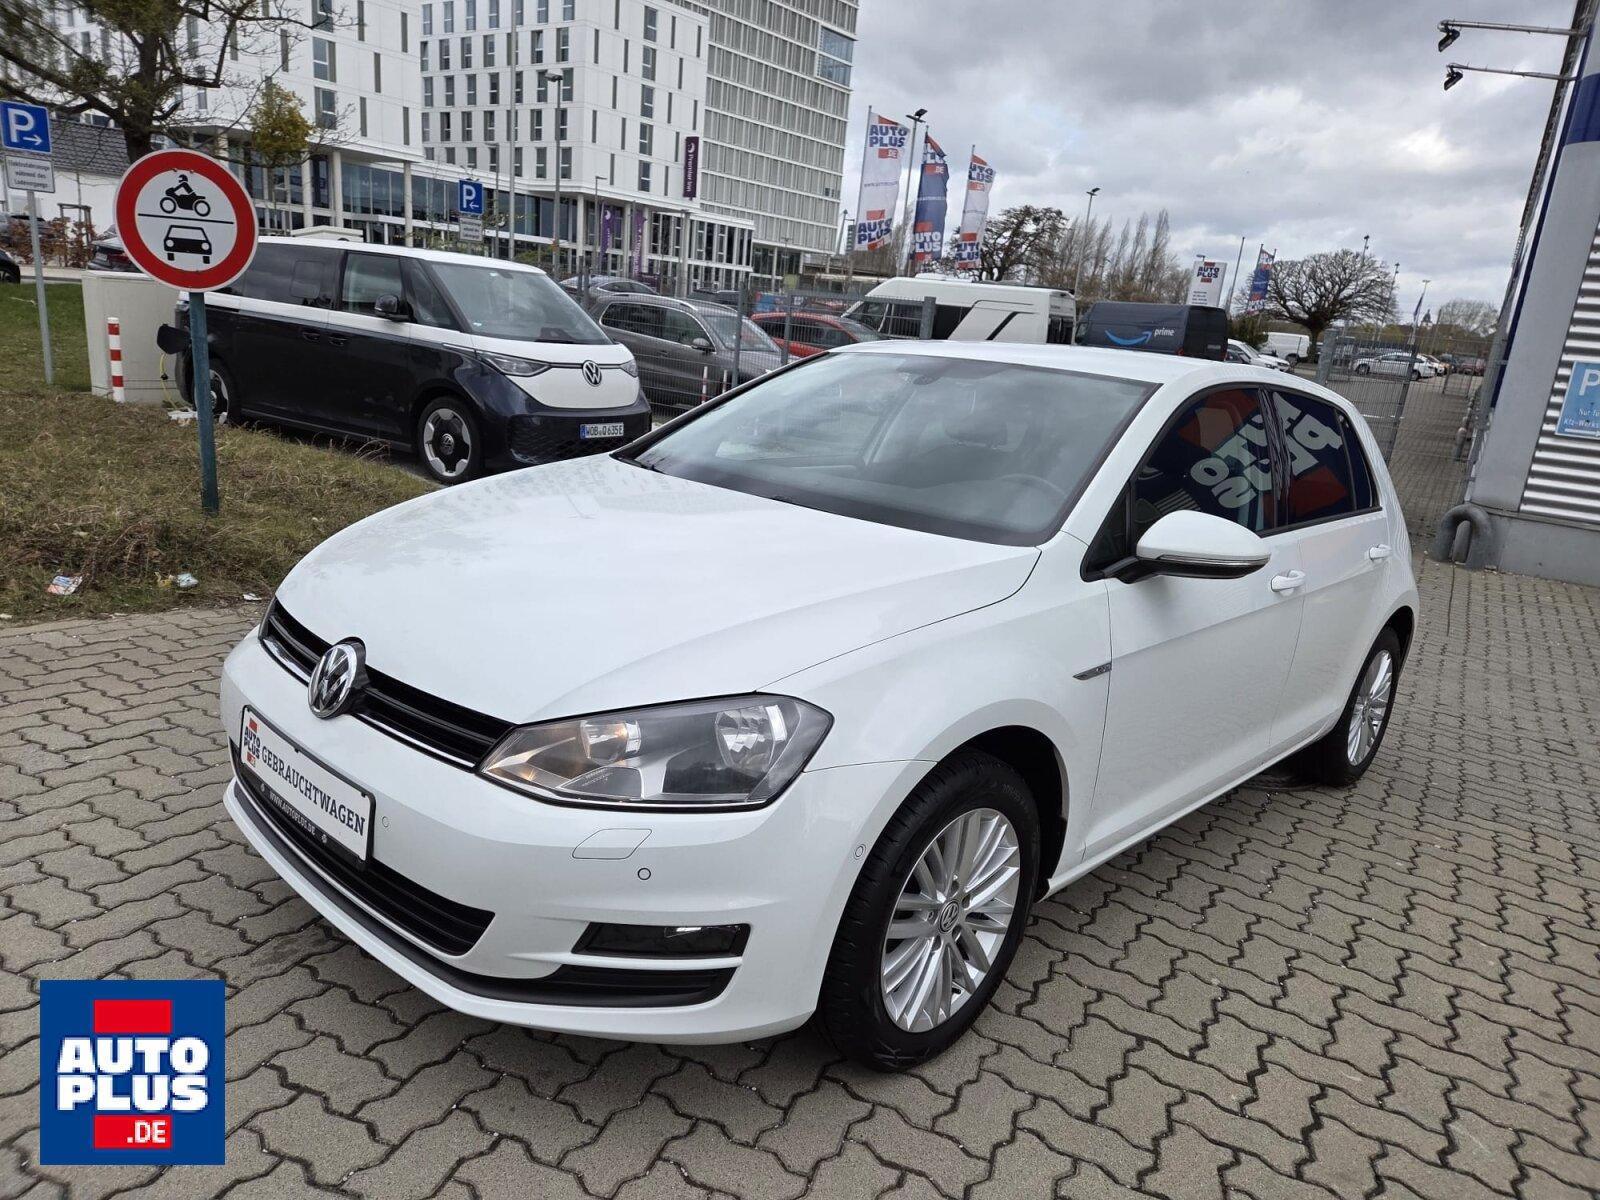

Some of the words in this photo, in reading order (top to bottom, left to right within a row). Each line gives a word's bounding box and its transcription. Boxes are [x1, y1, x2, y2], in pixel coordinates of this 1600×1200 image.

[8, 108, 34, 143] P
[869, 124, 907, 136] AUTO
[869, 136, 905, 147] PLUS
[969, 162, 994, 175] UTO
[969, 171, 993, 183] LUS
[463, 184, 476, 208] P
[858, 218, 892, 233] AUTO
[858, 228, 892, 244] PLUS
[1154, 328, 1175, 338] prime
[1579, 368, 1600, 396] P
[244, 726, 261, 749] AUTO
[244, 736, 261, 760] PLUS
[262, 745, 366, 837] GEBRAUCHTWAGEN
